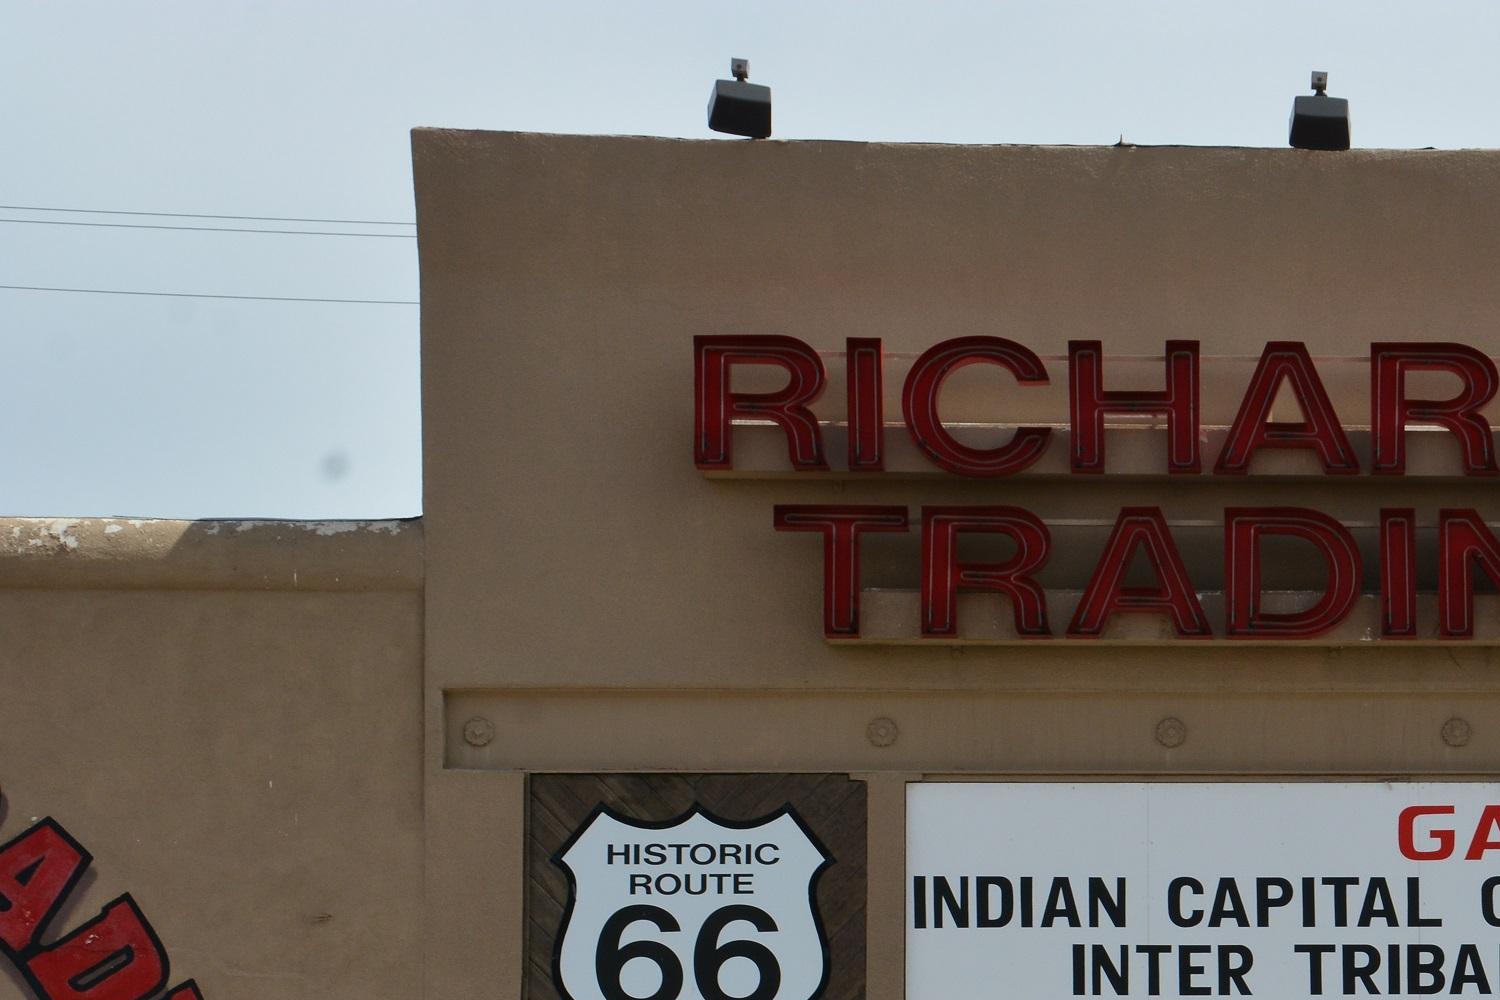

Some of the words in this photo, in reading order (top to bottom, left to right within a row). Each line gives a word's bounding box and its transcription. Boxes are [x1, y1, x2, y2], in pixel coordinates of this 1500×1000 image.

[608, 844, 779, 865] HISTORIC
[630, 874, 753, 895] ROUTE
[914, 876, 1125, 928] INDIAN
[1168, 877, 1442, 927] CAPITAL
[1073, 944, 1253, 995] INTER
